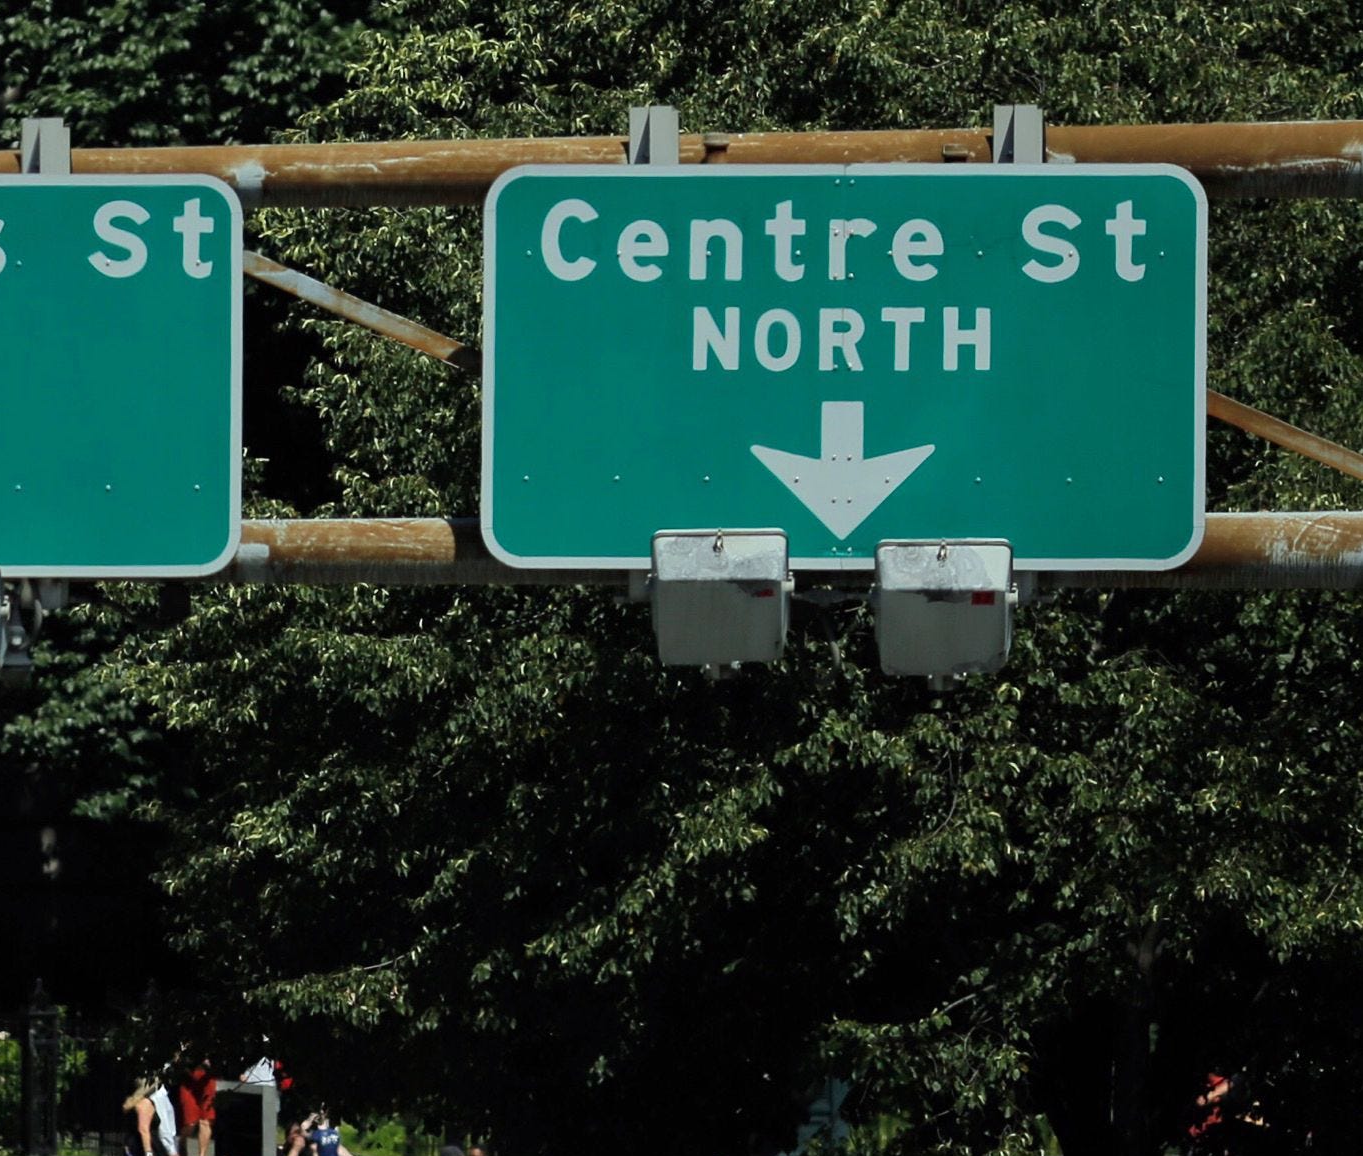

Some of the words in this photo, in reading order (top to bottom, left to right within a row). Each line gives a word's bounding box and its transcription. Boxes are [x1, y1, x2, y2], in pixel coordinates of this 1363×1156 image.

[88, 198, 215, 281] St
[540, 198, 944, 282] Centre
[1021, 200, 1148, 283] St
[692, 307, 991, 371] NORTH
